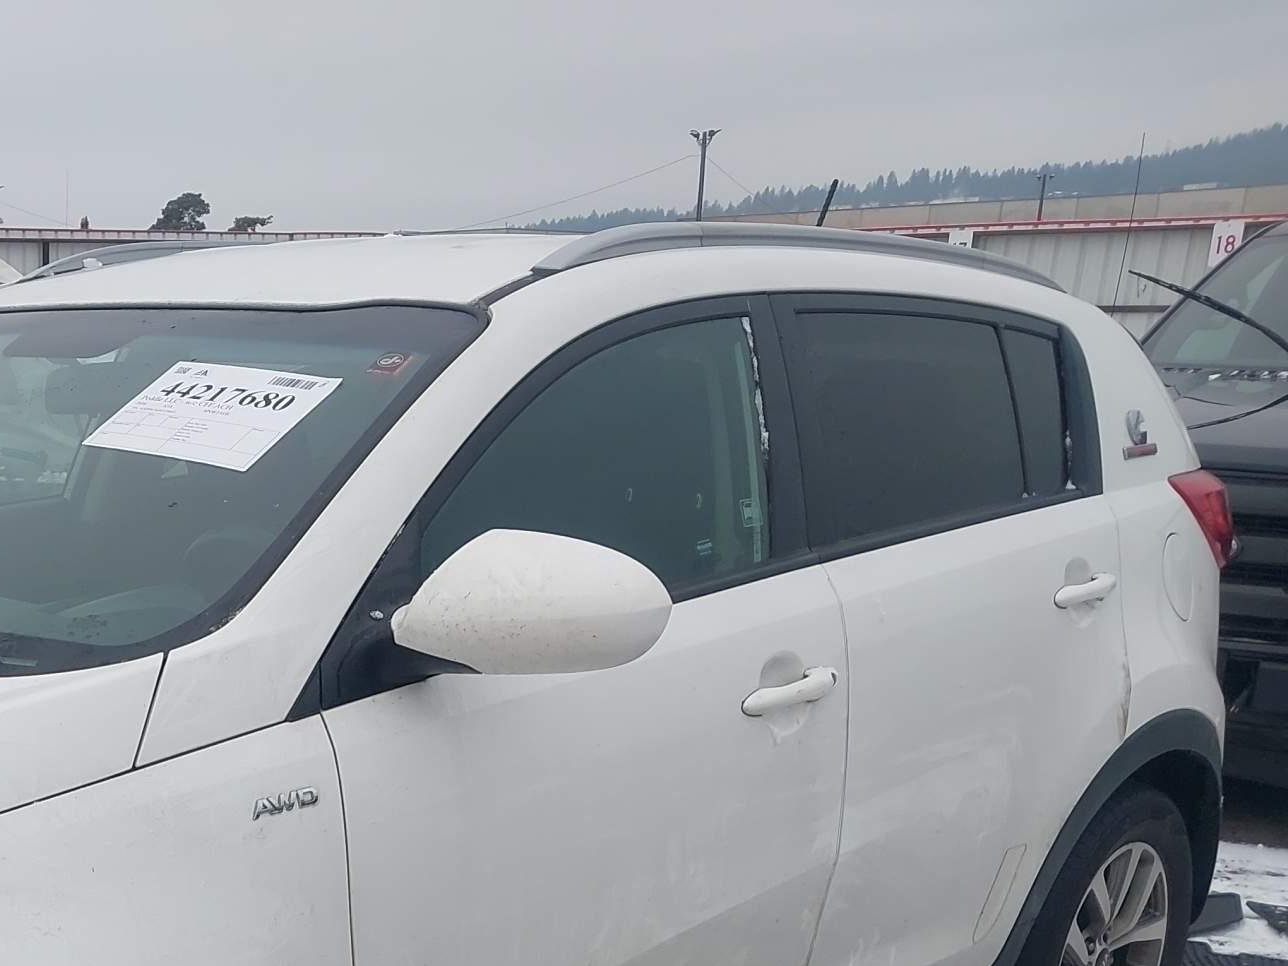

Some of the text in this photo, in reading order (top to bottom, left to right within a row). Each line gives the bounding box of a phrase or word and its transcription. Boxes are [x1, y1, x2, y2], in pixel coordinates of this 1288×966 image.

[1216, 234, 1236, 254] 18
[160, 381, 296, 411] 44217680
[252, 785, 318, 821] AWD
